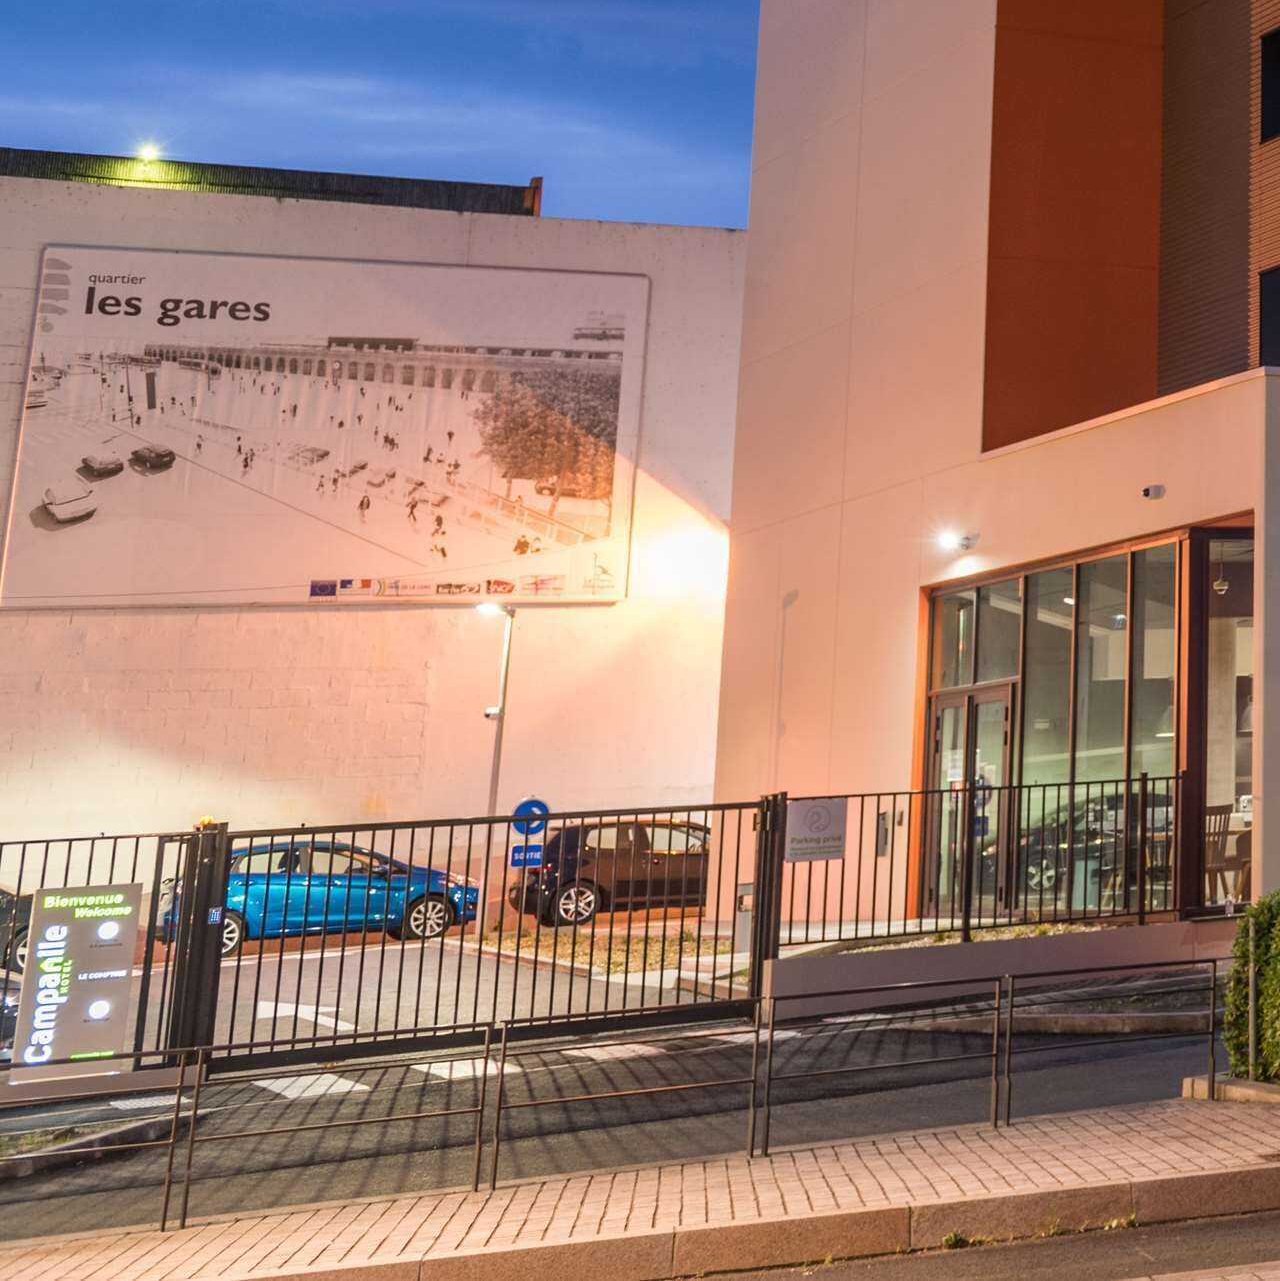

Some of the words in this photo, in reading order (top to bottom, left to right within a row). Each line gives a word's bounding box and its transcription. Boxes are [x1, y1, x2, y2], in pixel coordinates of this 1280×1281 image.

[88, 273, 146, 285] quartier
[84, 286, 143, 317] les
[156, 297, 271, 327] gares
[513, 851, 542, 860] SOTIE
[44, 894, 124, 909] Bienvenue
[74, 906, 132, 919] Welcome
[24, 925, 68, 1063] Campanile
